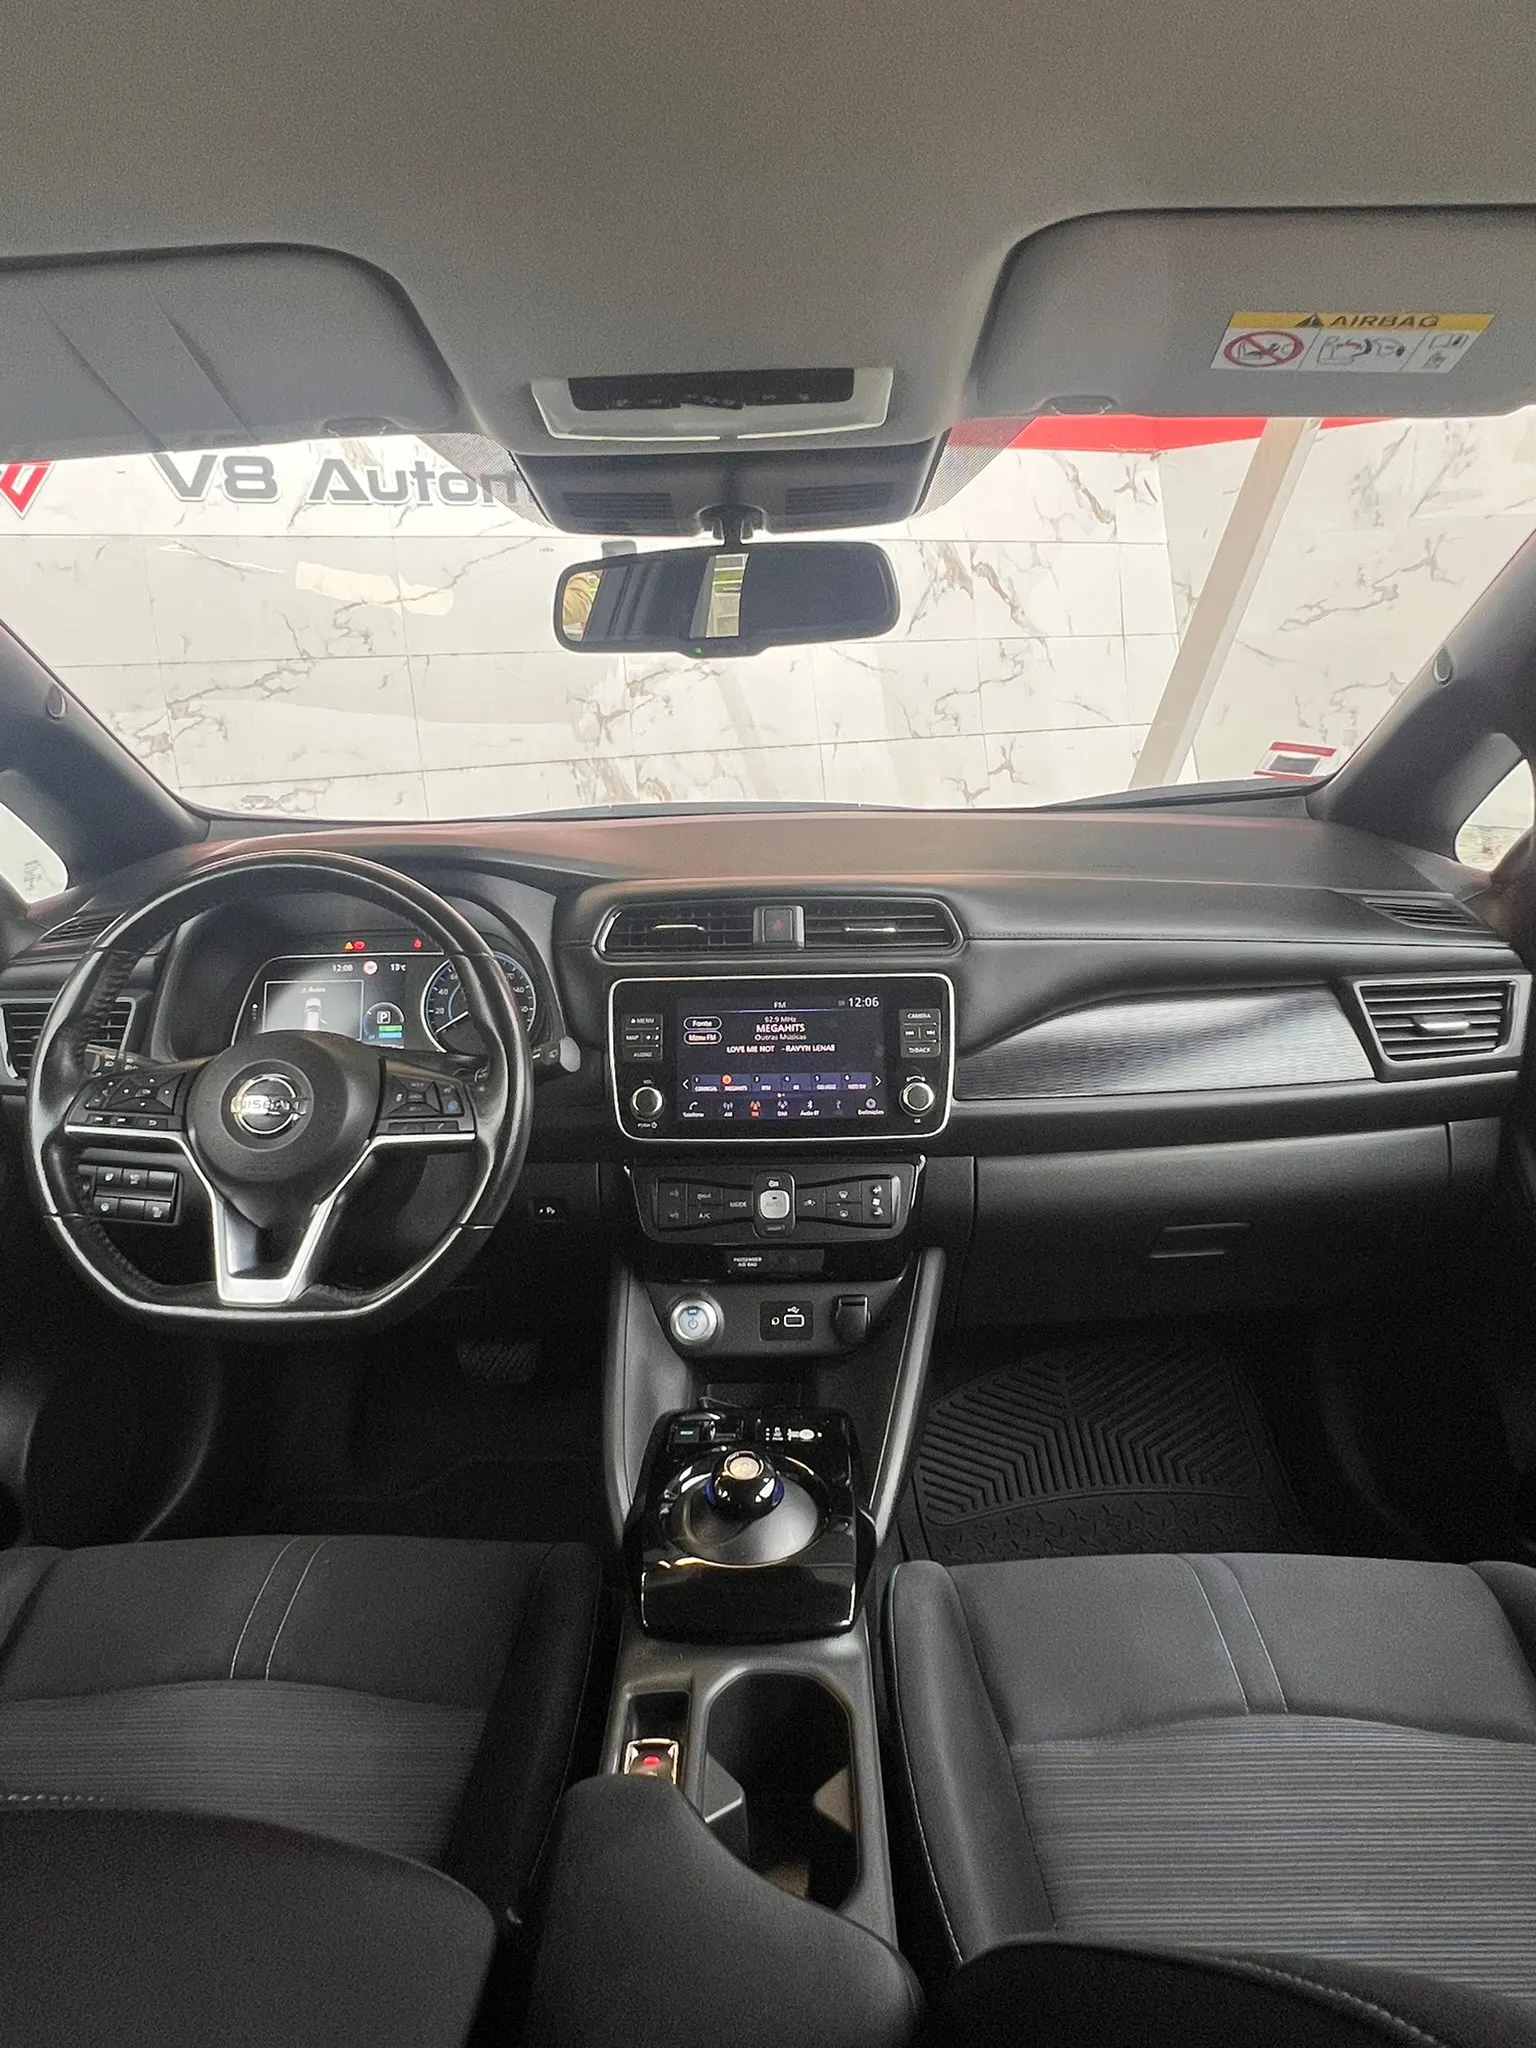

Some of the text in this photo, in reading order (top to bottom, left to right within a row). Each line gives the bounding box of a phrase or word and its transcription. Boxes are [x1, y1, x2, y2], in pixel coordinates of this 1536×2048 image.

[1330, 315, 1440, 328] AIRBAG
[153, 453, 279, 500] V8
[773, 1001, 787, 1009] FM
[848, 997, 880, 1008] 12:06
[755, 1023, 806, 1033] MEGAHITS
[726, 1045, 746, 1054] LOVE
[746, 1045, 758, 1053] ME
[759, 1045, 775, 1053] NOT
